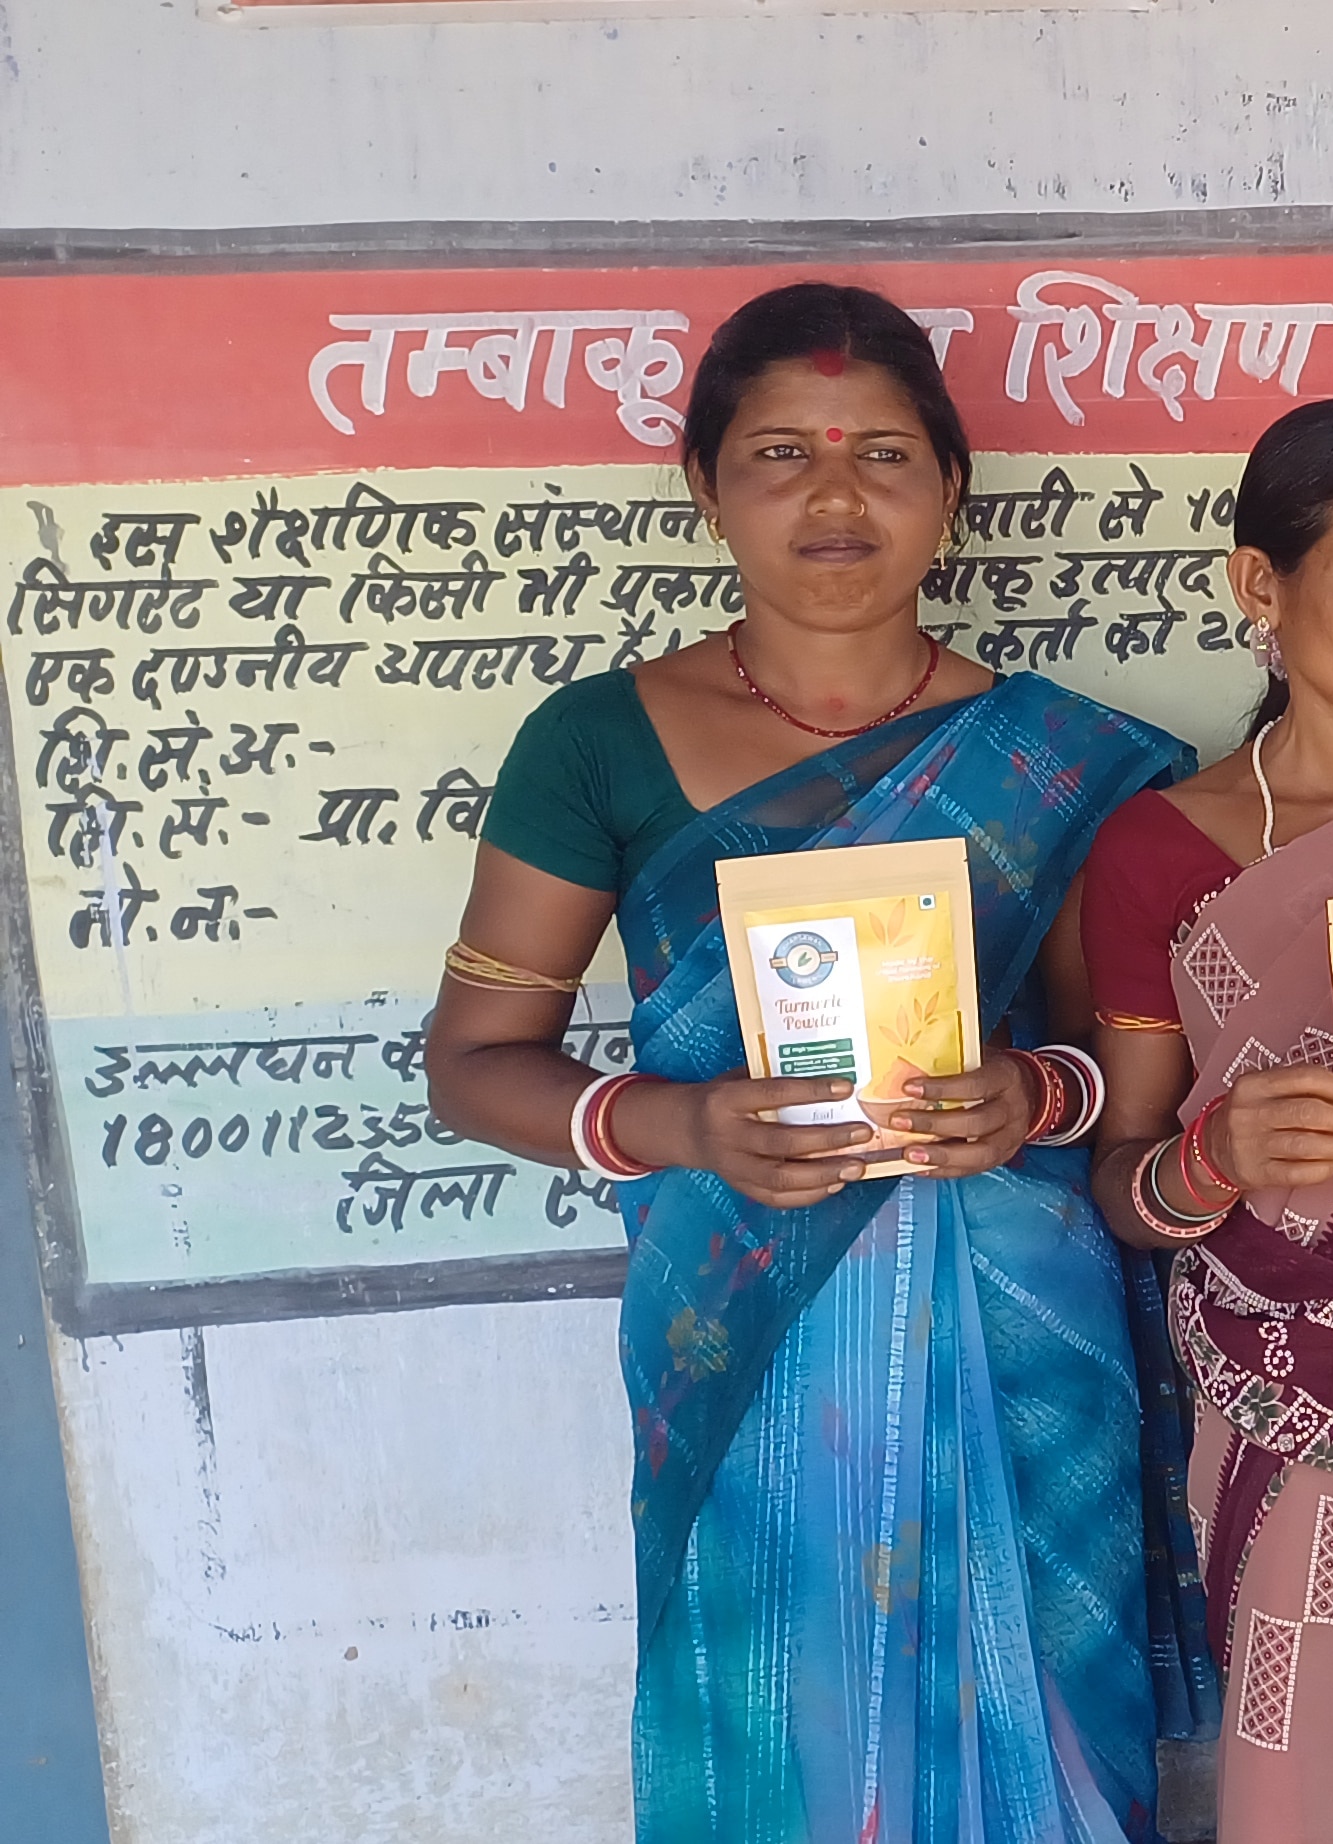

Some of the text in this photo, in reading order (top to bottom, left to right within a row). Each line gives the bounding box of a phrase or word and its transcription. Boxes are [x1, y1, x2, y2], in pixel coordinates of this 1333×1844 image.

[308, 310, 689, 446] तम्बाकू
[90, 513, 201, 570] इस
[209, 482, 484, 568] शैक्षणिक
[494, 484, 699, 559] संस्थान
[1100, 462, 1164, 541] से
[229, 576, 331, 621] या
[339, 549, 506, 623] किसी
[517, 554, 598, 619] भी
[25, 649, 115, 706] एक
[1105, 594, 1187, 664] को
[337, 1151, 516, 1233] जिला
